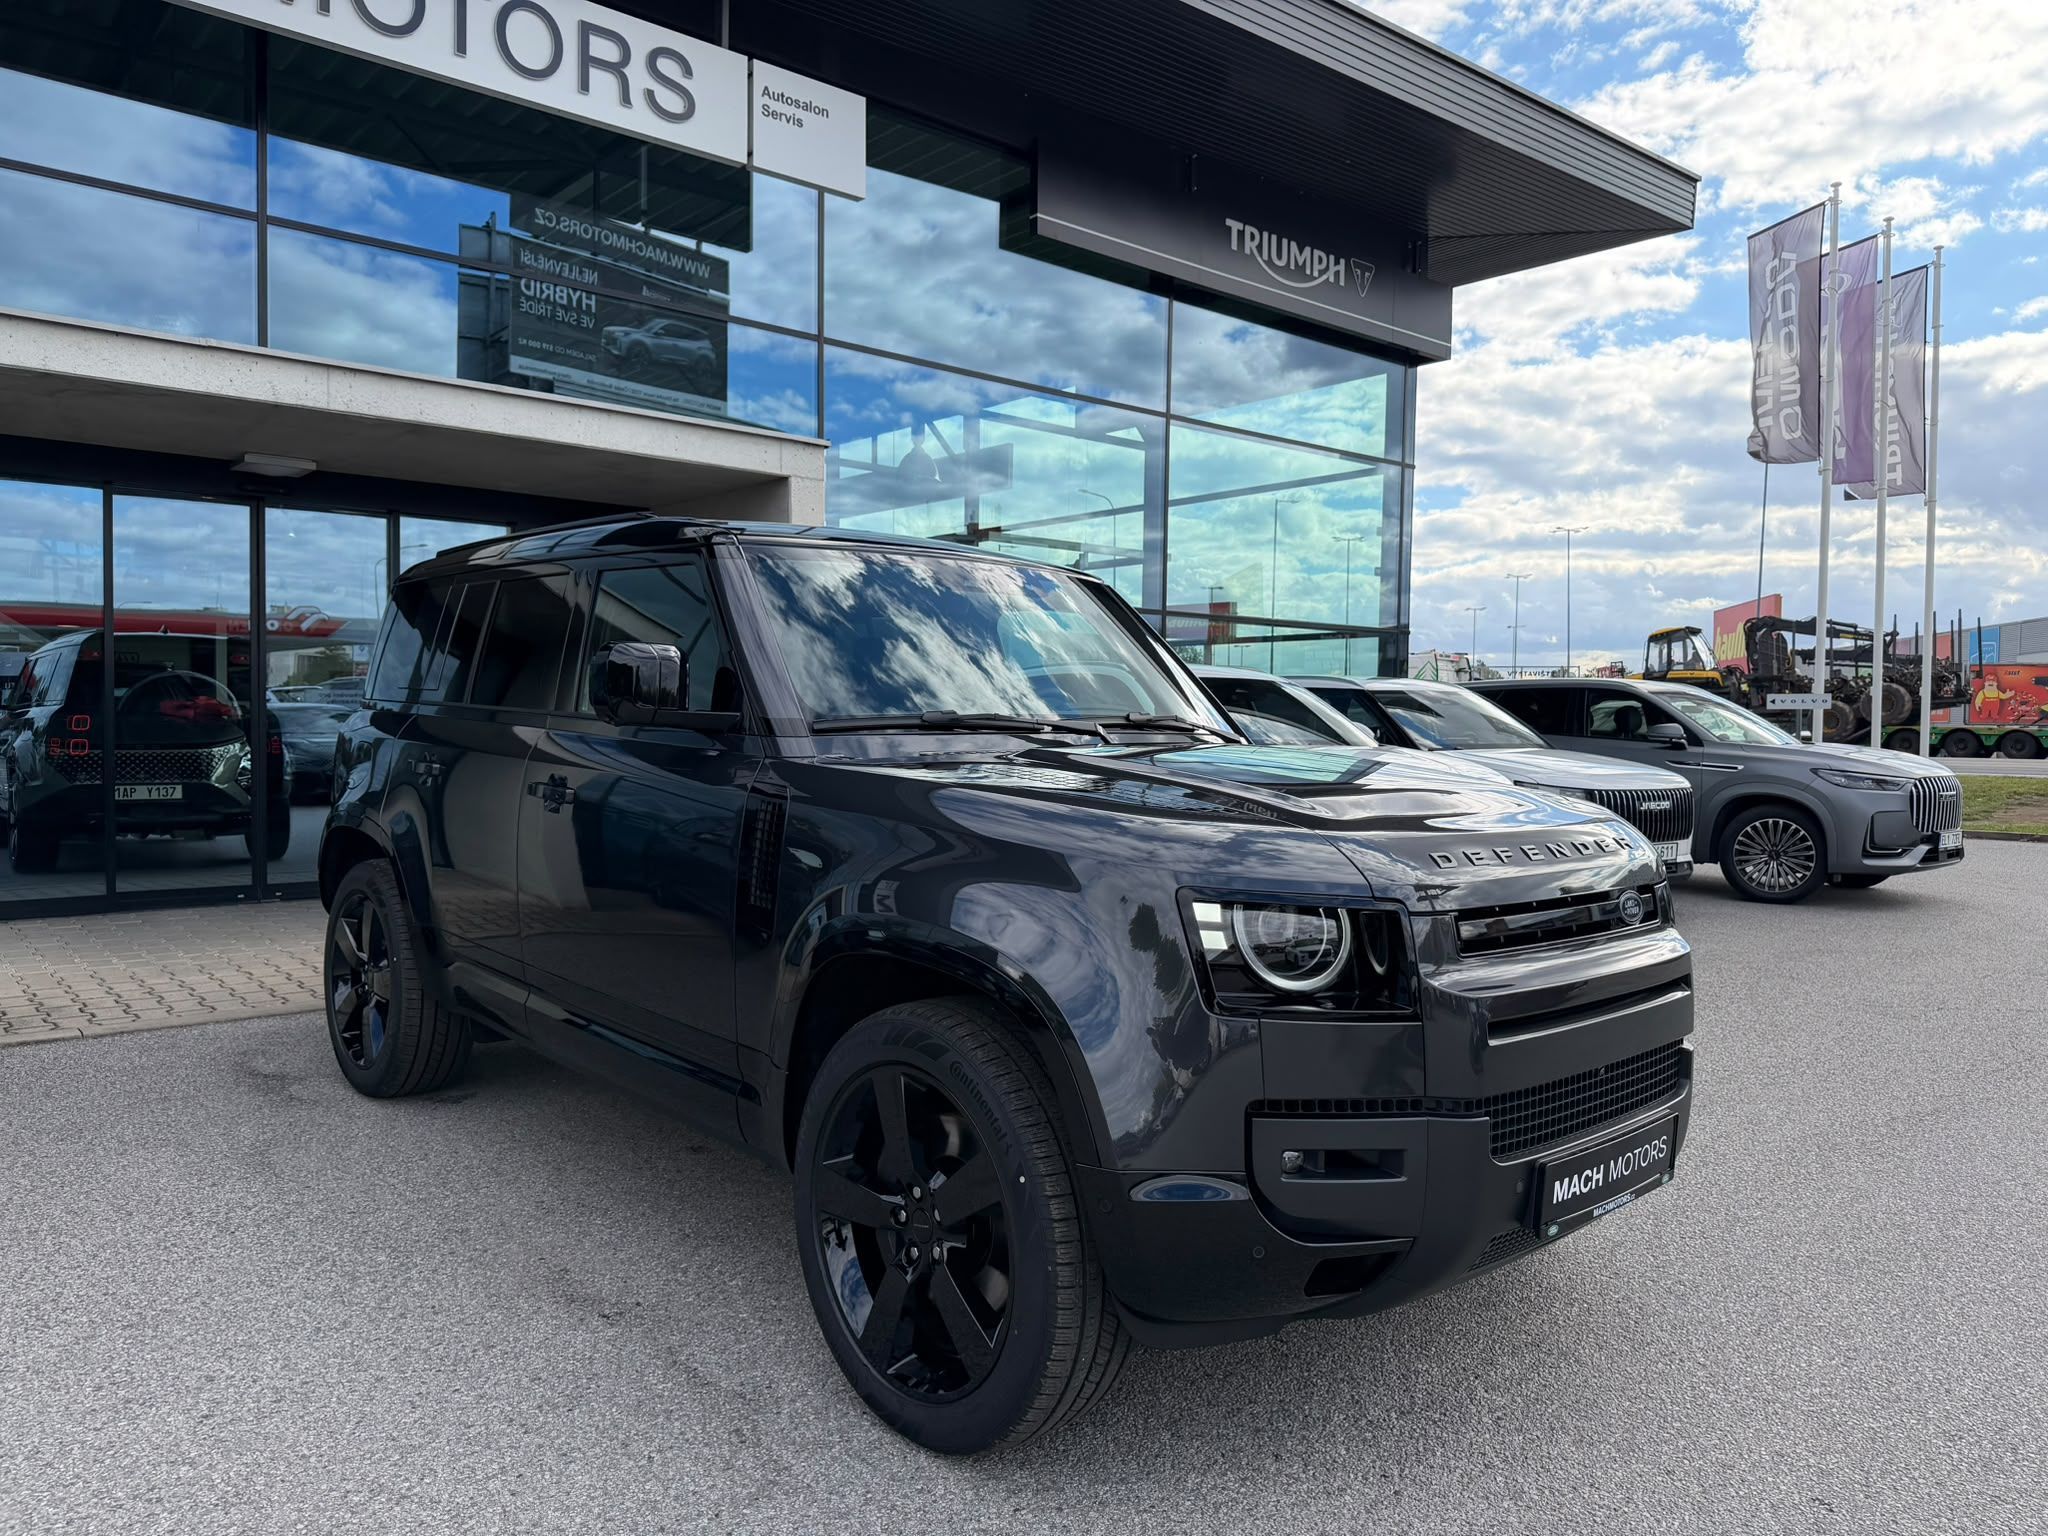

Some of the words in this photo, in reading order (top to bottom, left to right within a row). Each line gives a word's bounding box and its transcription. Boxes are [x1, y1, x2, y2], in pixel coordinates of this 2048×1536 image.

[761, 85, 829, 119] Autosalon
[761, 103, 804, 128] Servis
[1225, 218, 1346, 287] TRIUMPH
[115, 787, 136, 798] 1AP
[147, 786, 176, 798] Y137
[1428, 837, 1634, 869] DEFENDER
[1656, 845, 1674, 858] 611
[1552, 1164, 1604, 1204] MACH
[1608, 1135, 1668, 1182] MOTORS
